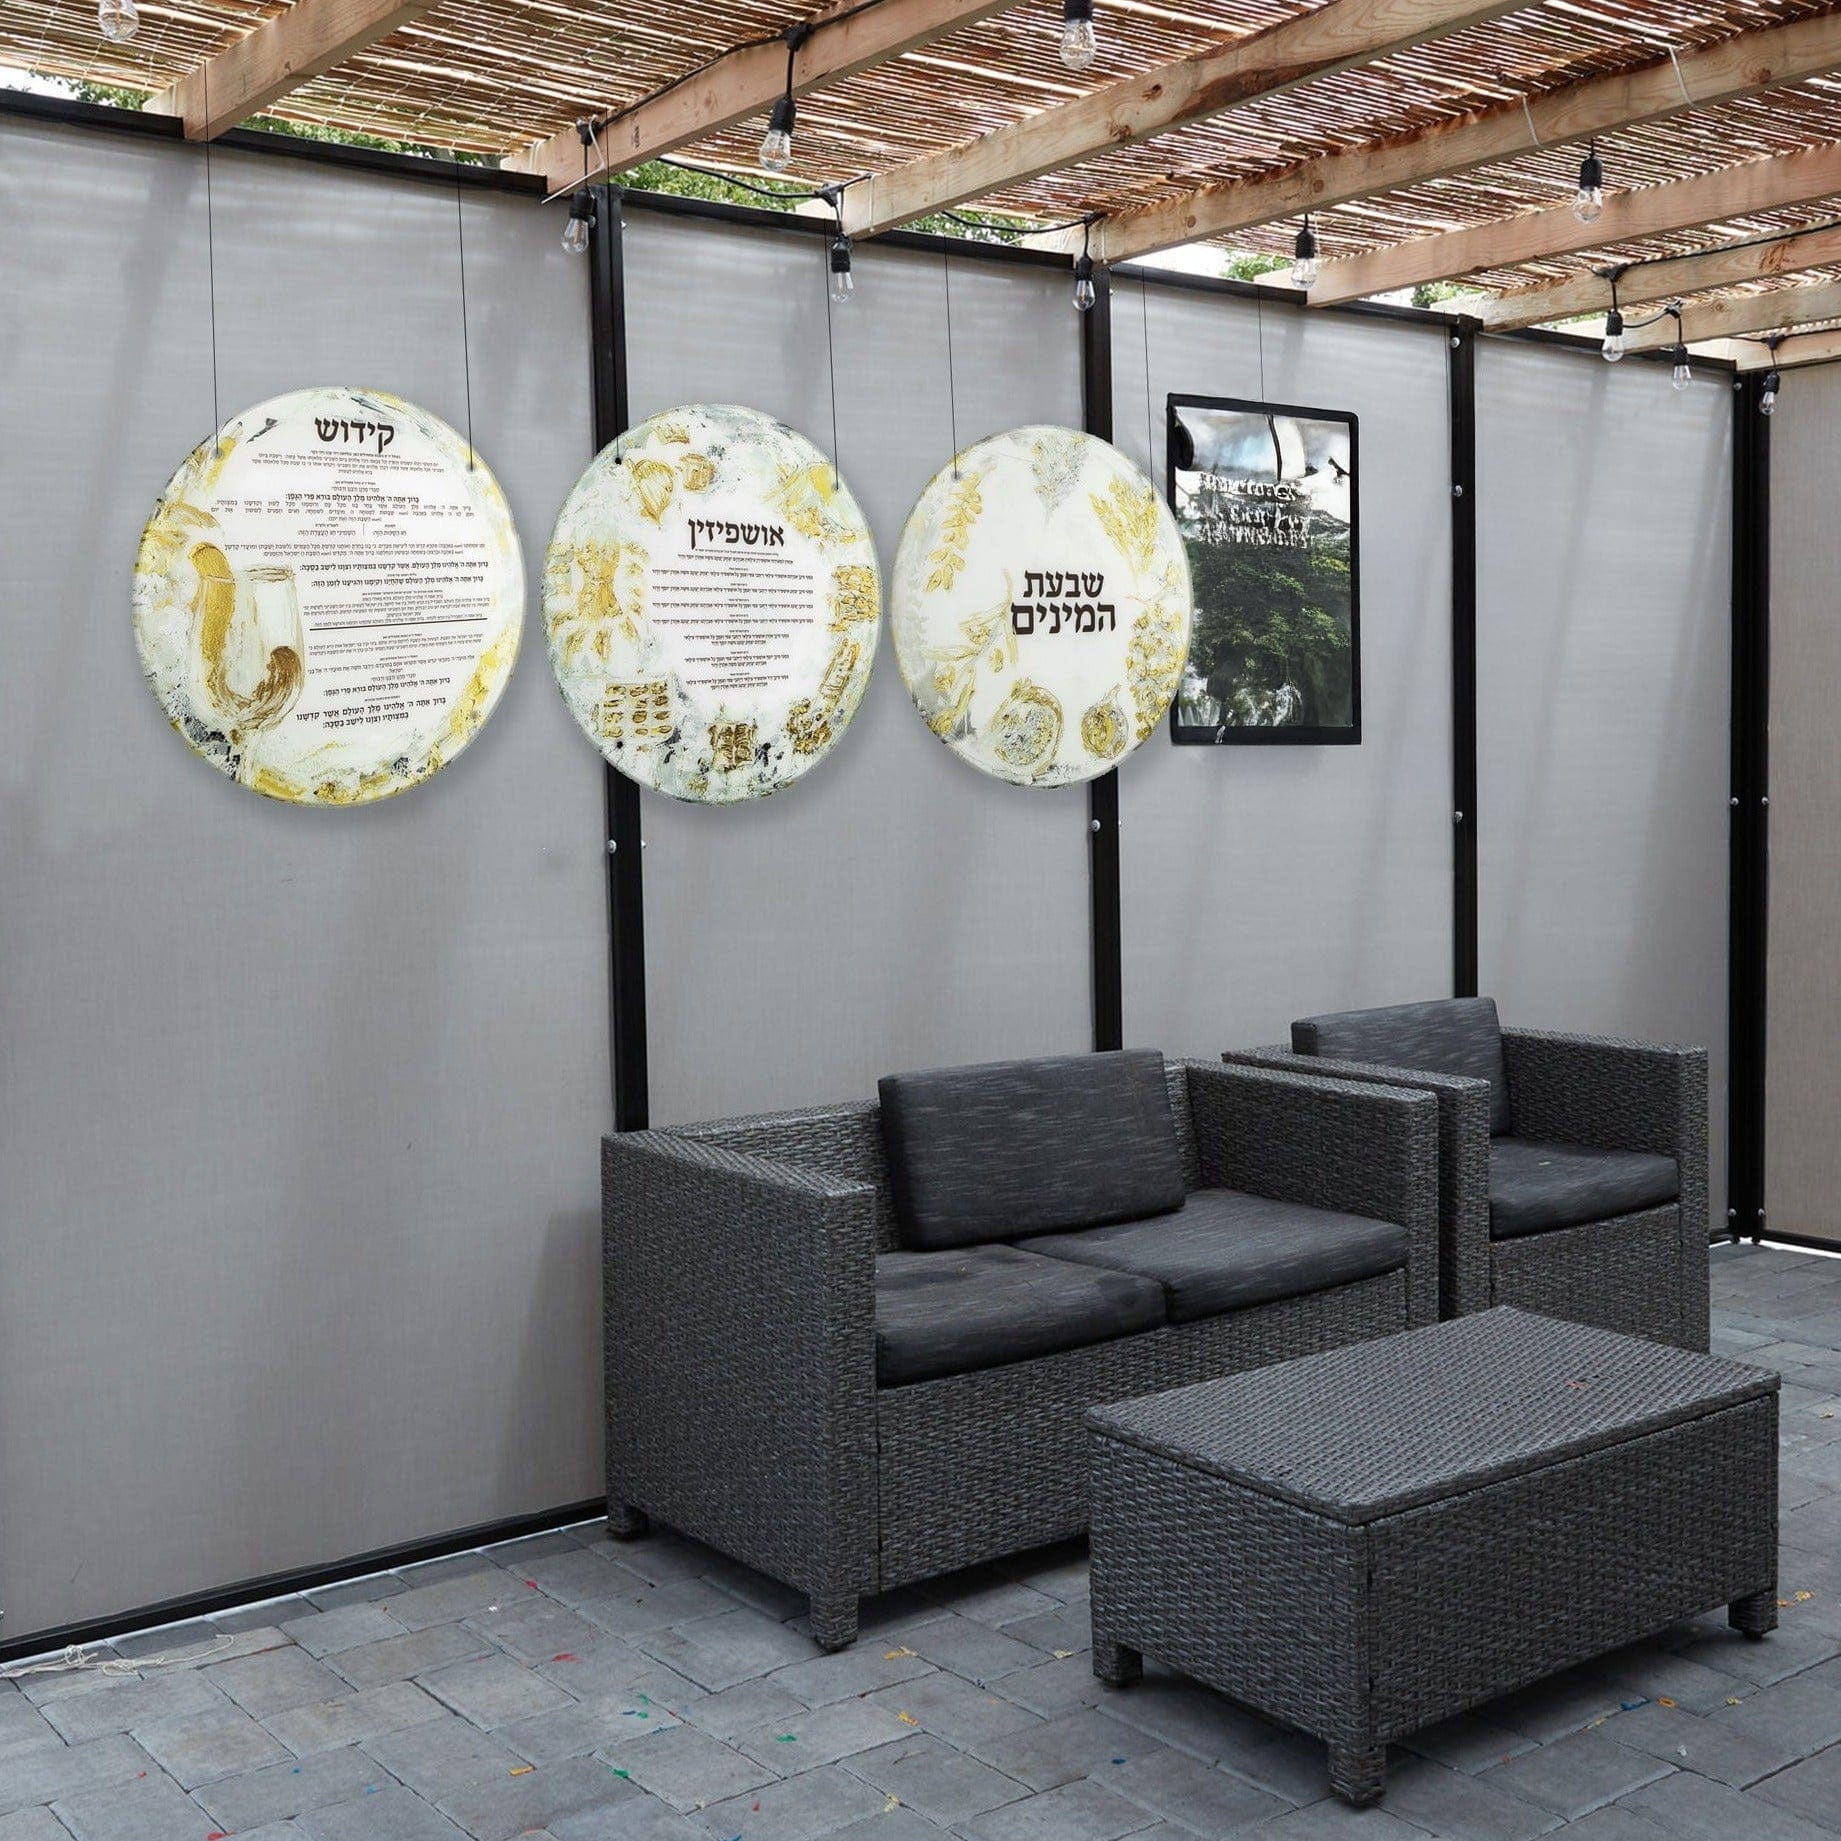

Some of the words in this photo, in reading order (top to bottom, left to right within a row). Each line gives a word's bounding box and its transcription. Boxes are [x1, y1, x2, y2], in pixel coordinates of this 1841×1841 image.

[314, 417, 395, 453] קידוש
[688, 518, 784, 549] אושפיזין
[1023, 570, 1104, 597] שבעת
[1011, 602, 1116, 634] המינים
